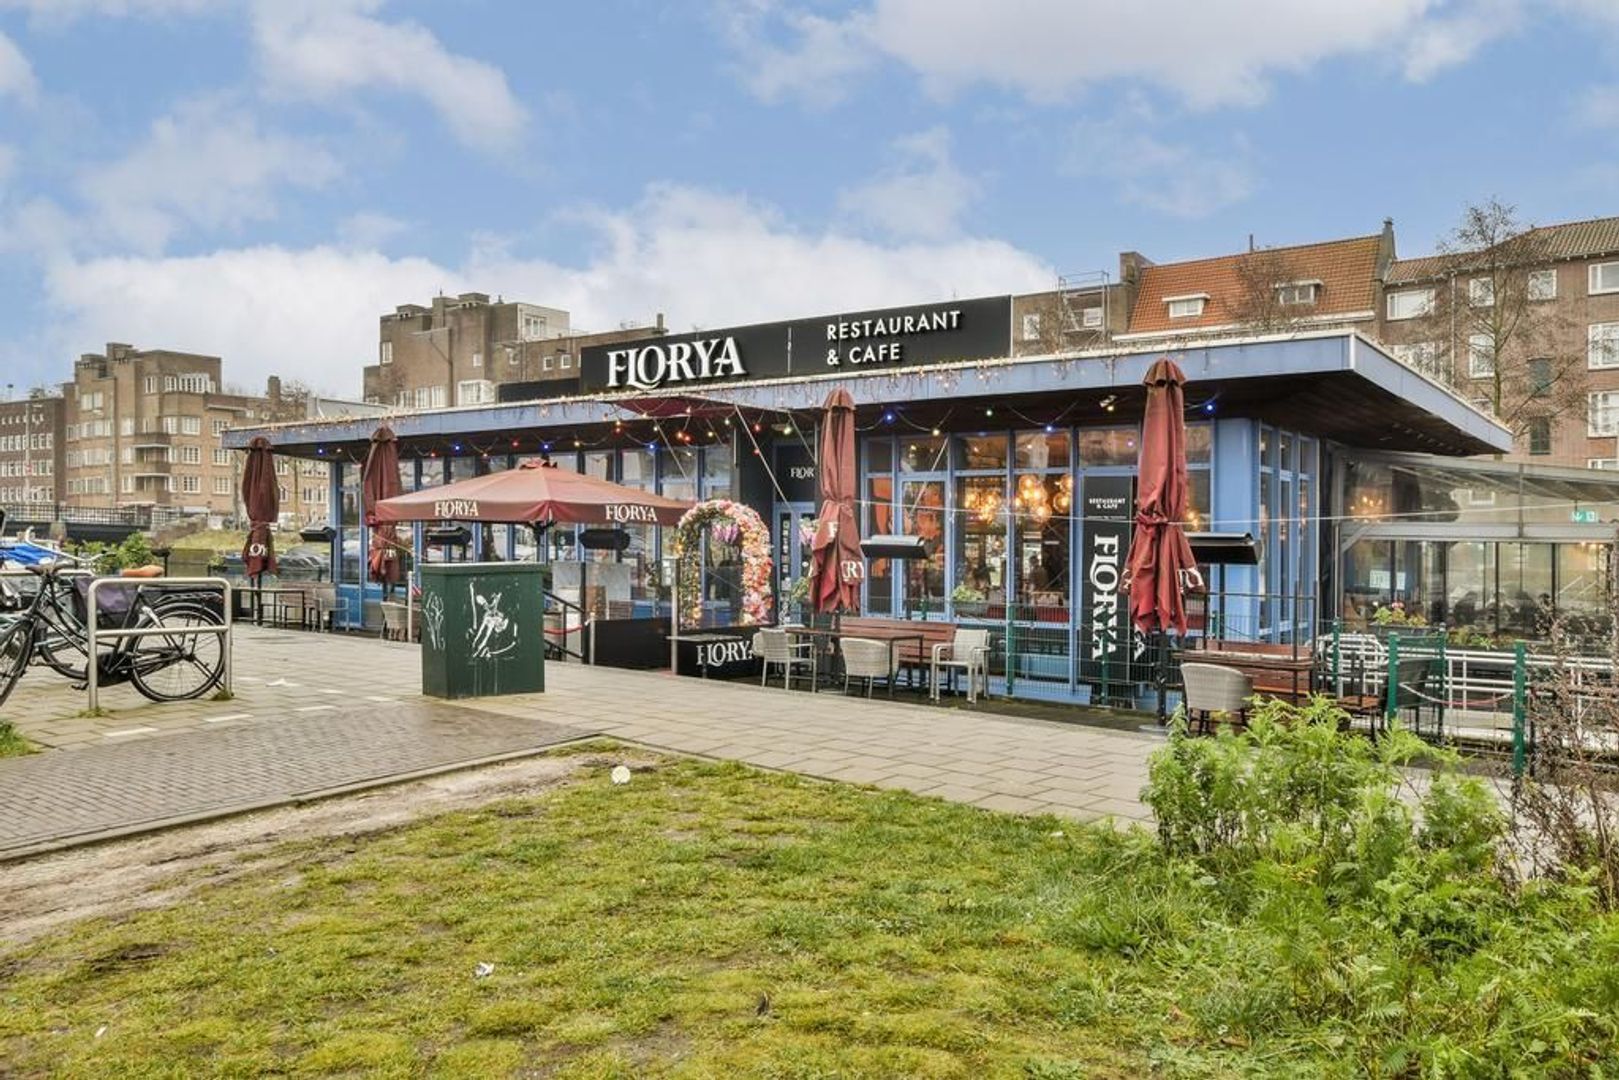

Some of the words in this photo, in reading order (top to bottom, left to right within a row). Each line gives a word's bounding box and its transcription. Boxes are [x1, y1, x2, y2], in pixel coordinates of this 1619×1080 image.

[827, 310, 960, 341] RESTAURANT
[607, 336, 747, 390] FLORYA
[826, 349, 839, 366] &
[849, 343, 900, 364] CAFE
[434, 500, 480, 519] FLORYA
[605, 504, 658, 523] FLORYA
[1090, 533, 1119, 662] FLORYA
